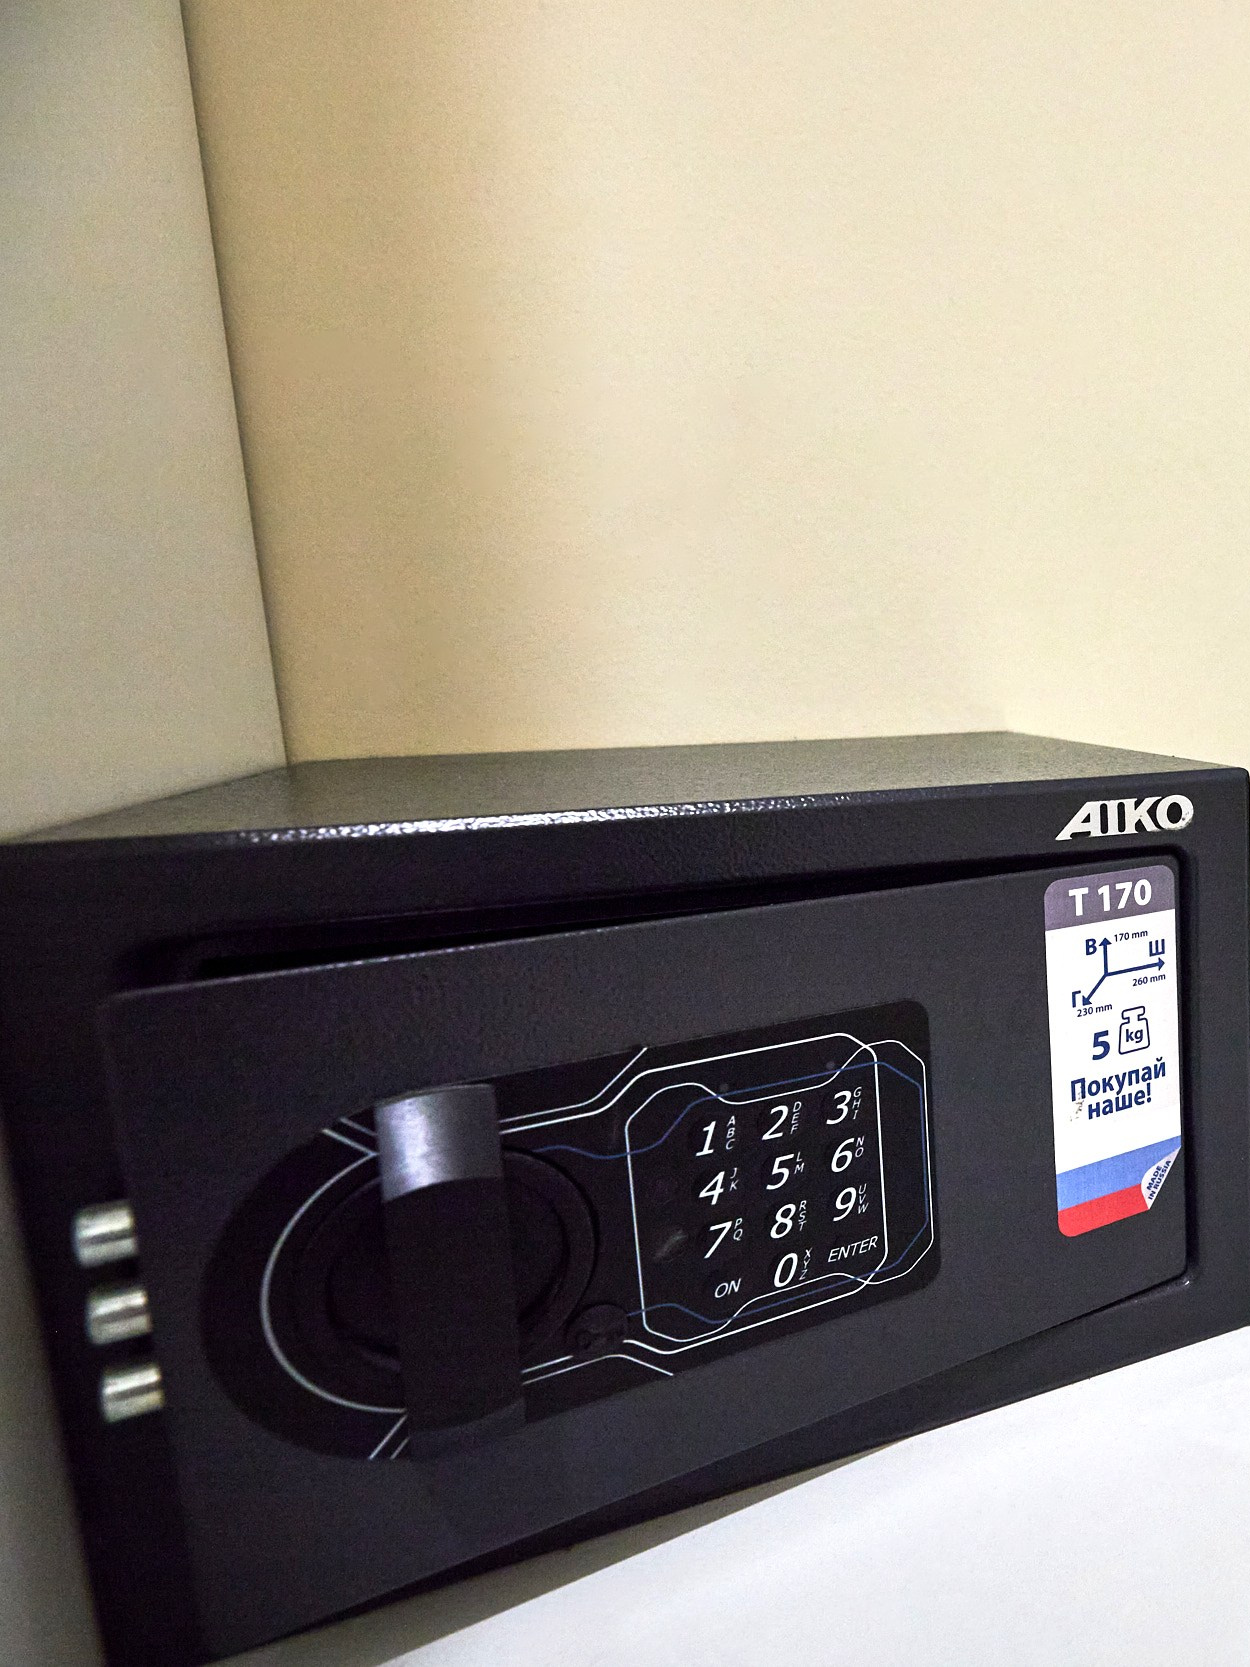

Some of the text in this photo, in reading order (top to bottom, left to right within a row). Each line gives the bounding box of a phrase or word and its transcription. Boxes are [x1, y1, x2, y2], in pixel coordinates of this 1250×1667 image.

[1055, 794, 1194, 841] AIKO
[1068, 878, 1152, 917] T 170
[1114, 930, 1148, 943] 170 mm
[1149, 938, 1166, 957] Ш
[1132, 973, 1166, 987] 260 mm
[1076, 1002, 1113, 1018] 230 mm
[1092, 1028, 1144, 1061] 5 kg
[1070, 1056, 1167, 1102] Покупай
[826, 1090, 852, 1125] 3
[1087, 1082, 1152, 1120] наше!
[695, 1121, 717, 1157] 1
[761, 1105, 789, 1141] 2
[766, 1153, 795, 1190] 5
[831, 1138, 855, 1173] 6
[698, 1171, 726, 1206] 4
[1146, 1165, 1163, 1191] MADE
[1148, 1160, 1171, 1201] IN RUSSIA
[770, 1203, 796, 1239] 8
[832, 1186, 857, 1222] 9
[703, 1220, 733, 1259] 7
[827, 1235, 879, 1263] ENTER
[773, 1252, 798, 1288] 0
[714, 1278, 742, 1299] ON
